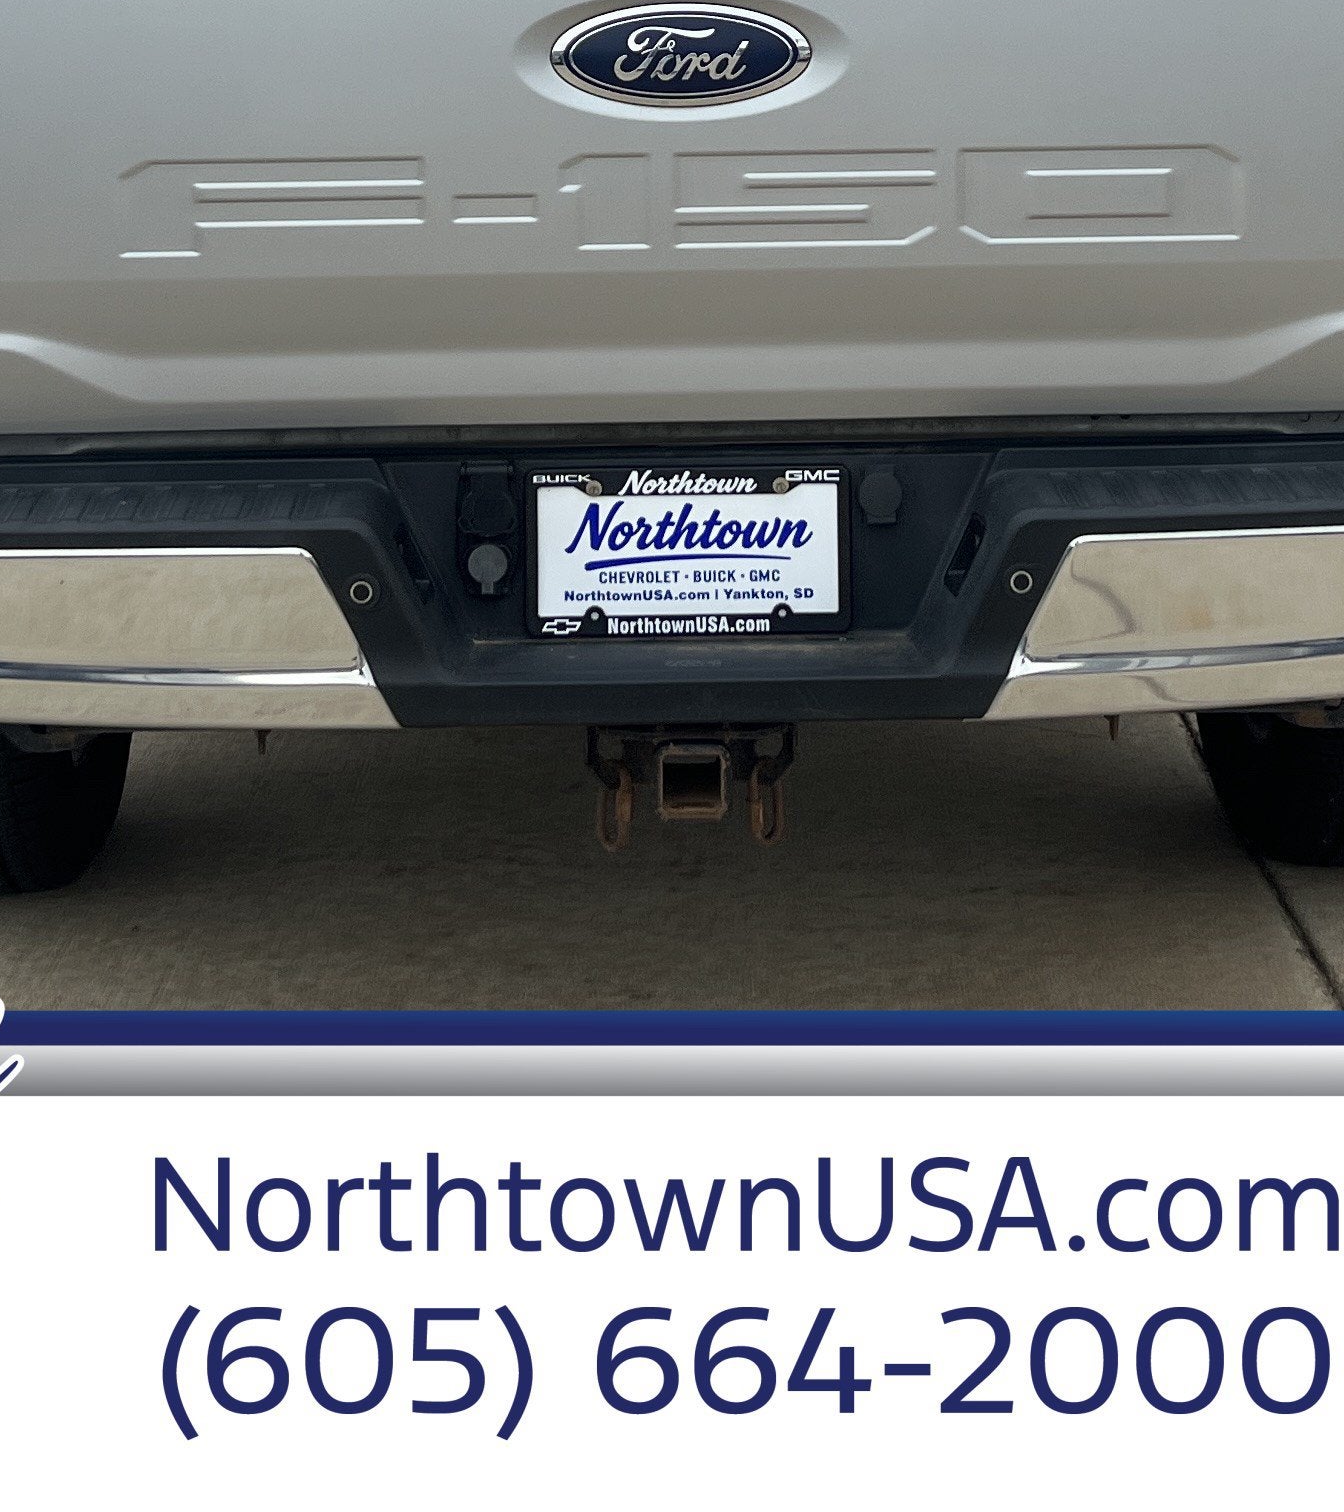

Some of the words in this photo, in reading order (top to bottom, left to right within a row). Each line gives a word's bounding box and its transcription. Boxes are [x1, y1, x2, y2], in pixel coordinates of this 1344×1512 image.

[613, 25, 752, 84] Ford
[118, 144, 1242, 259] F-150
[532, 473, 592, 484] BUICK
[618, 470, 759, 496] Northtown
[784, 469, 841, 482] GMC
[564, 500, 814, 555] Northtown
[598, 570, 681, 584] CHEVROLET
[693, 569, 737, 583] BUICK
[748, 569, 782, 582] GMC
[564, 588, 710, 602] NorthtownUSA.com
[724, 587, 790, 602] Yankton,
[793, 587, 815, 599] SD
[607, 616, 771, 635] NorthtownUSA.com
